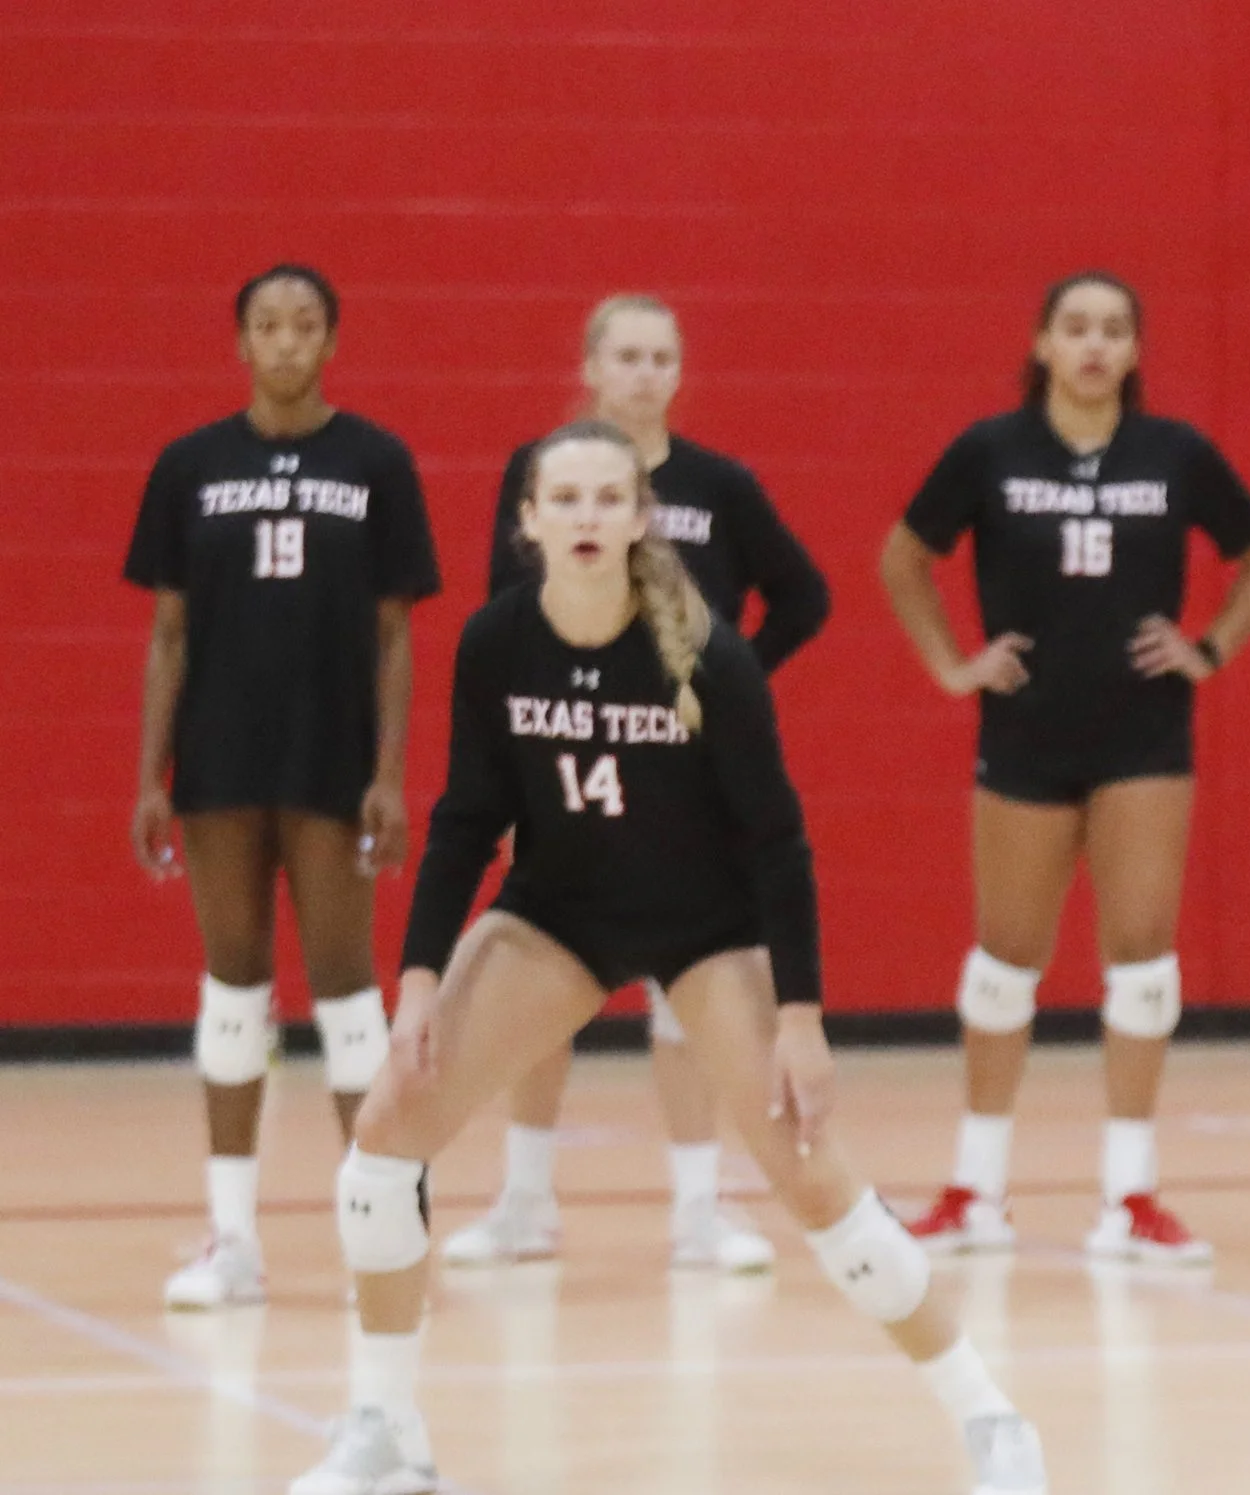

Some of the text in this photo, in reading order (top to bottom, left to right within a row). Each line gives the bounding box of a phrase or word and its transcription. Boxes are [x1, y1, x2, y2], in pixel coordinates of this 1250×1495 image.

[200, 478, 370, 522] TEXAS TECH
[253, 517, 304, 579] 19
[1060, 517, 1113, 577] 16
[506, 695, 594, 741] EXAS
[556, 752, 625, 817] 14
